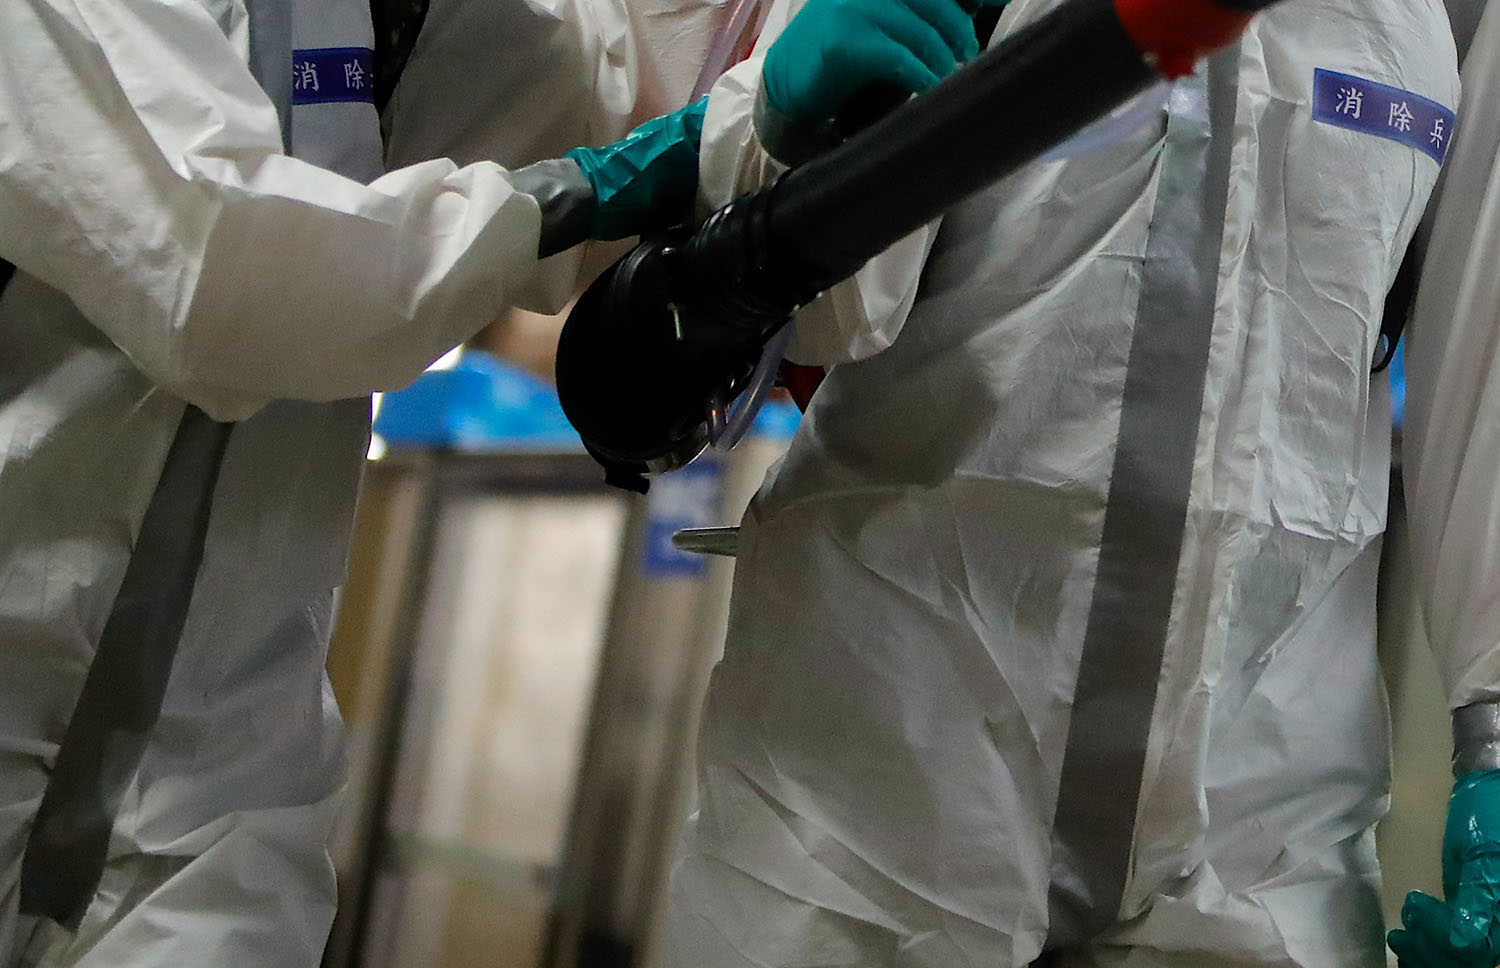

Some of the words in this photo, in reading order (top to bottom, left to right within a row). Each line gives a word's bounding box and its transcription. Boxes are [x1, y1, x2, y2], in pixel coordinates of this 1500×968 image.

[294, 58, 373, 92] 消除
[1335, 87, 1445, 149] 消除兵
